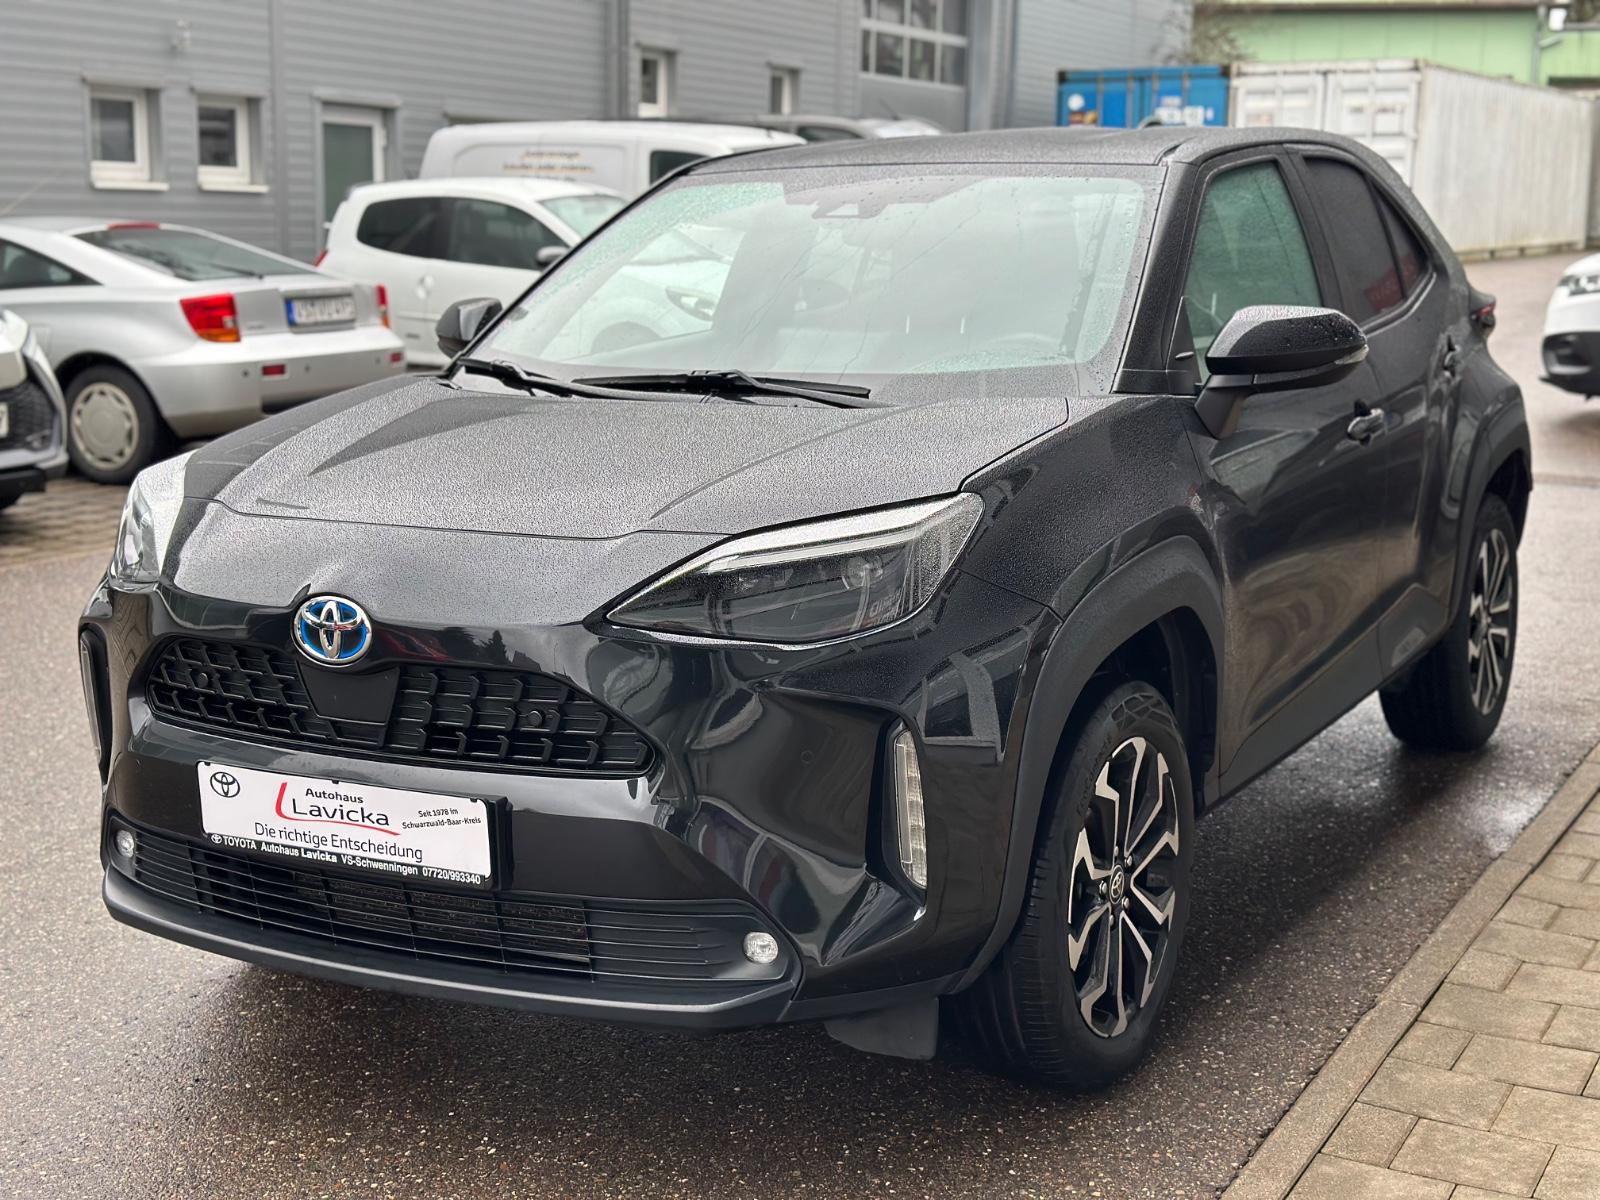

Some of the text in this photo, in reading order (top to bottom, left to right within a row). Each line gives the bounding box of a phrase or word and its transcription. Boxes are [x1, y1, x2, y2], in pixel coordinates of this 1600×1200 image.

[305, 787, 364, 804] Autohaus
[292, 798, 390, 826] Lavicka
[402, 817, 481, 829] Schwarzwald-Baar-Kreis
[418, 807, 459, 818] Seit 1978 im
[254, 822, 423, 864] Die richtige Entscheidung
[223, 836, 481, 885] TOYOTA Autohaus Lavicka VS-Schwenningen 07720/993340
